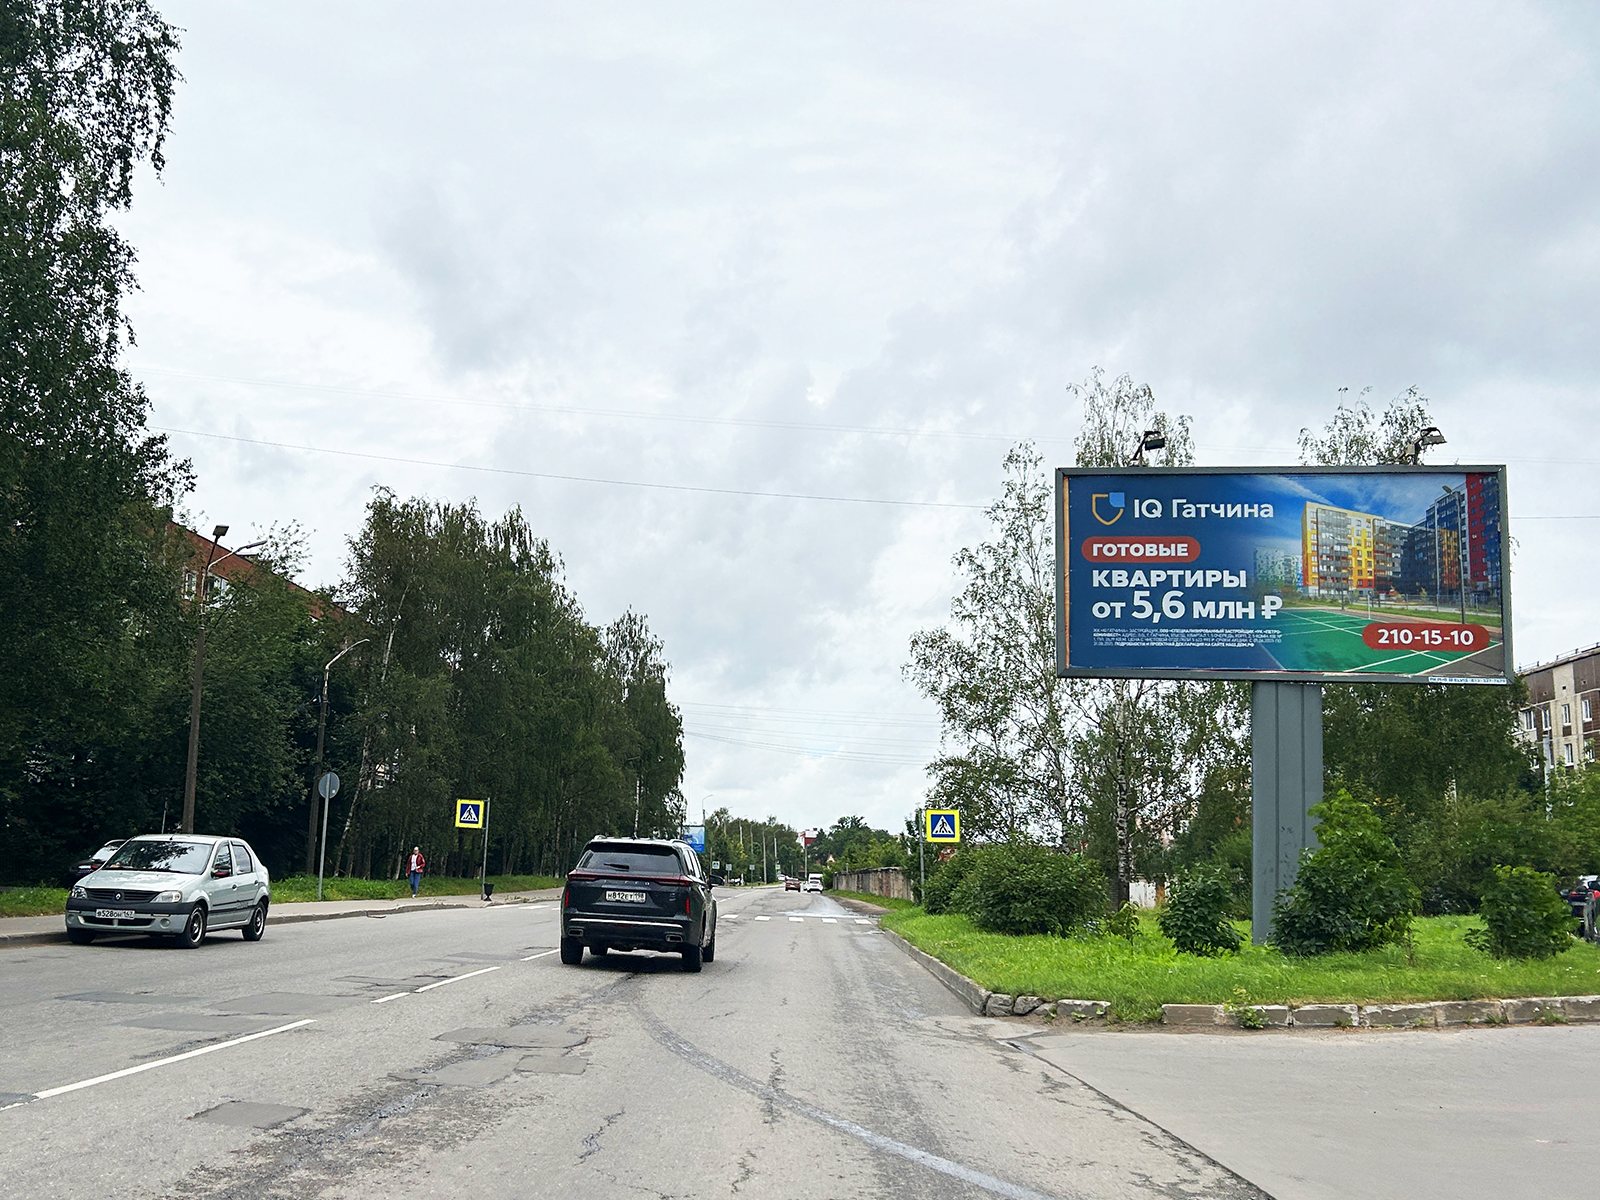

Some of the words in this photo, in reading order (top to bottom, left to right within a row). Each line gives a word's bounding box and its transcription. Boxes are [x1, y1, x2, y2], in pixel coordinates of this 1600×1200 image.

[1133, 499, 1163, 519] IQ
[1172, 499, 1274, 519] Гатчина
[1092, 543, 1189, 557] ГОТОВЫЕ
[1092, 569, 1247, 588] КВАРТИРЫ
[1131, 590, 1186, 623] 5,6
[1377, 629, 1474, 645] 210-15-10
